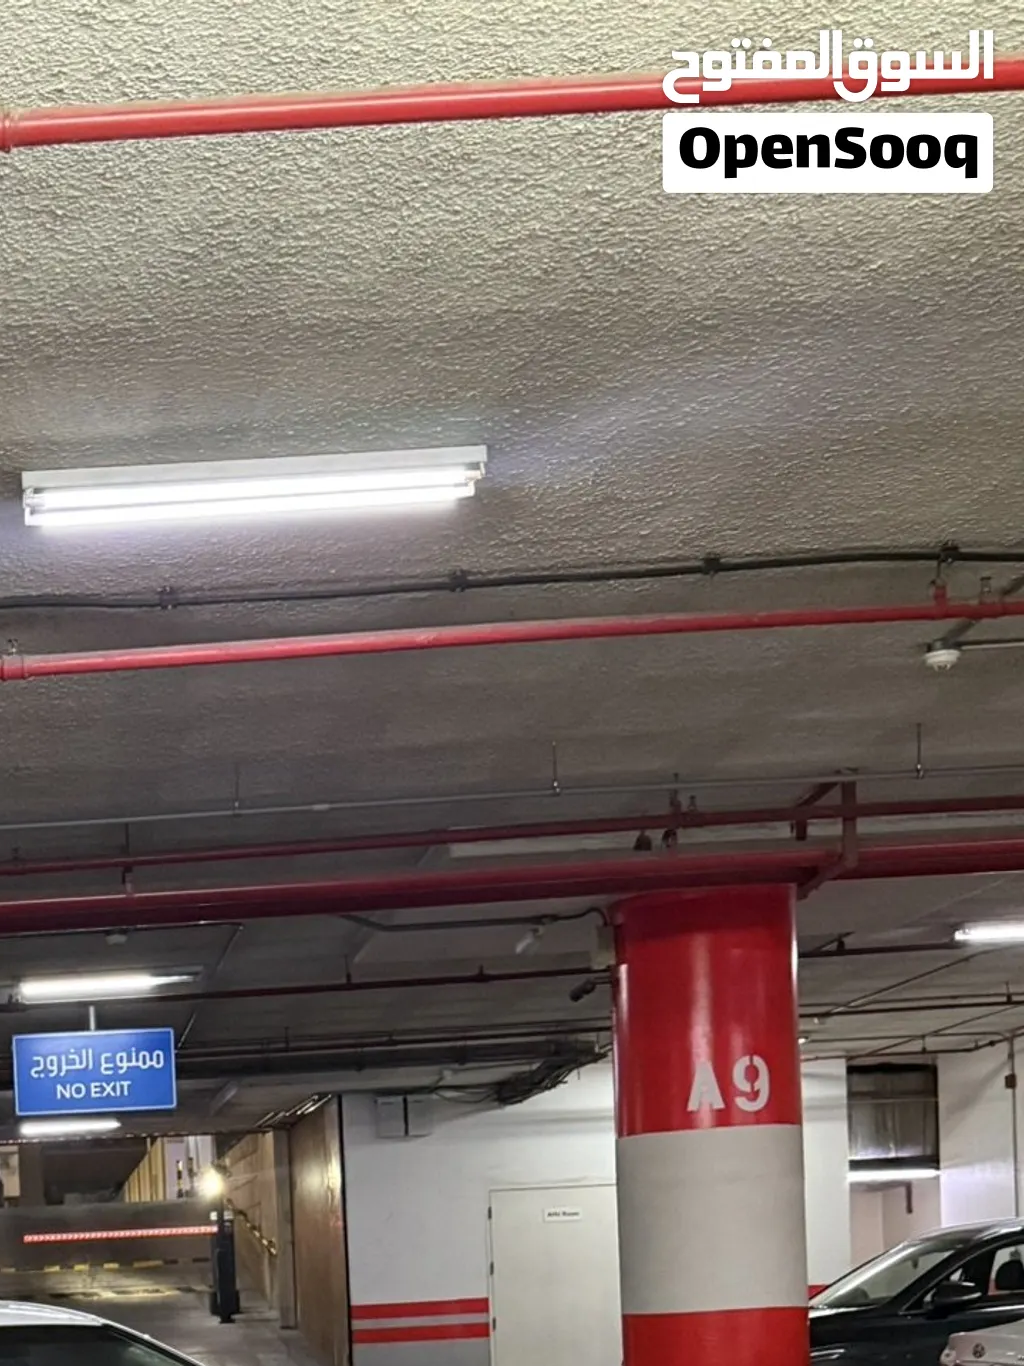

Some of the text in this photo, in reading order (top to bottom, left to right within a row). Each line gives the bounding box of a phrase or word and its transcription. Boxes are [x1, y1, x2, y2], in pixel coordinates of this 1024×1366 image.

[30, 1047, 164, 1078] ممنوع الخروج
[56, 1080, 132, 1099] NO EXIT
[687, 1054, 770, 1112] A9
